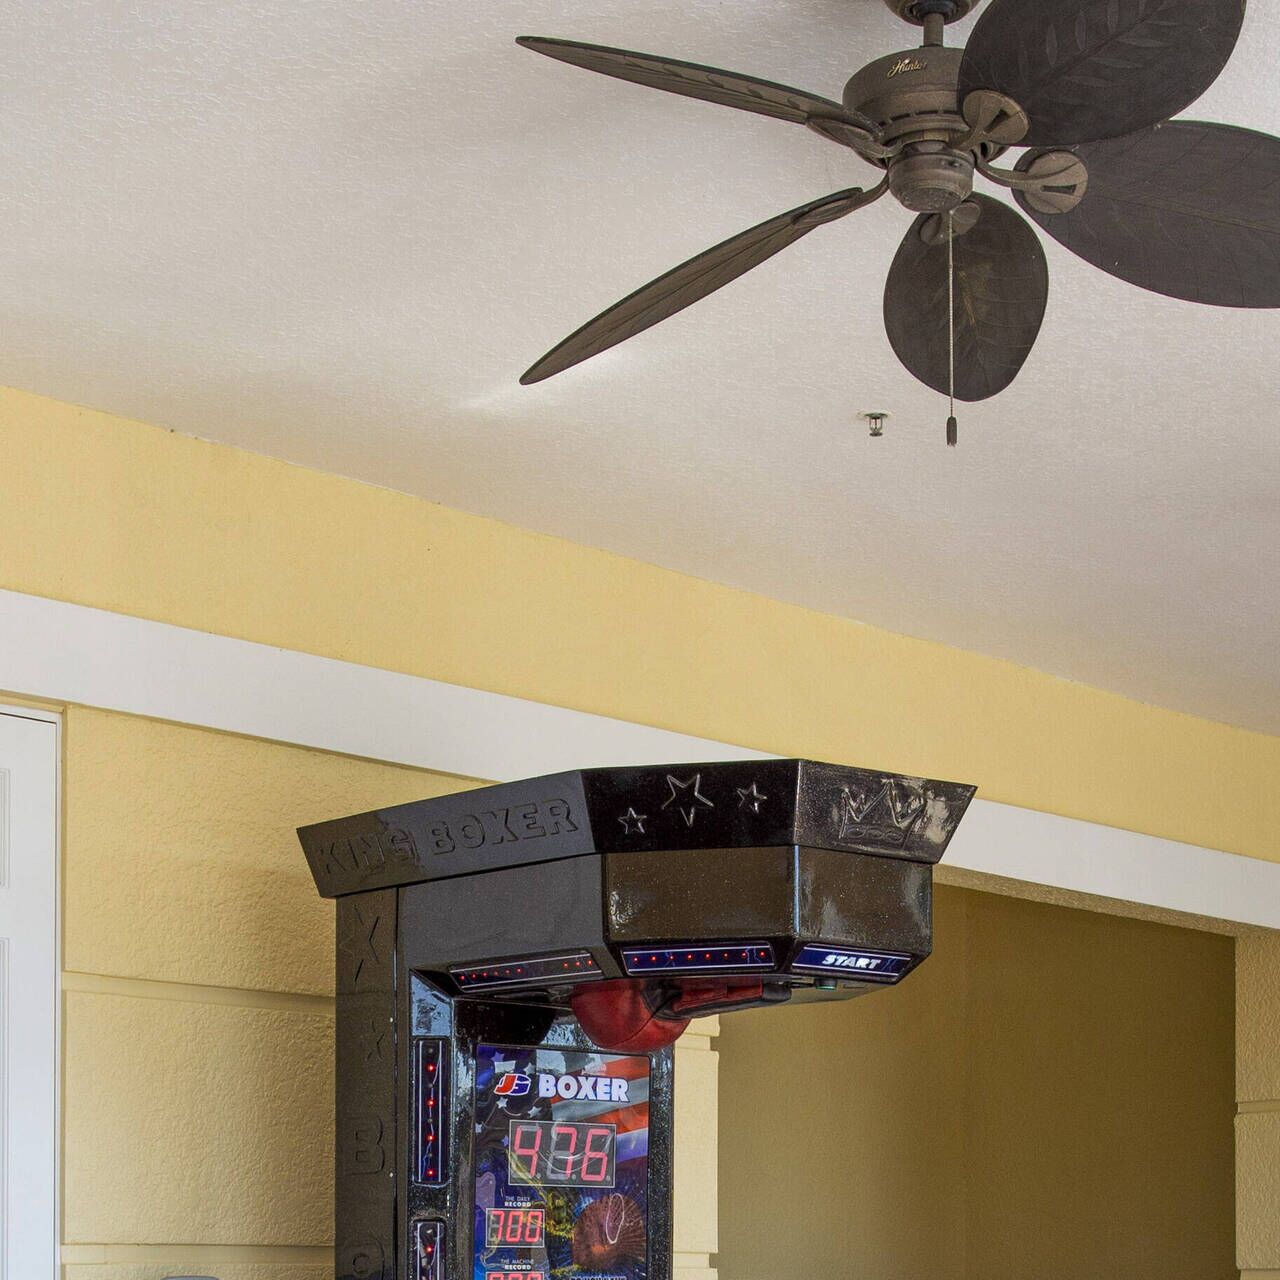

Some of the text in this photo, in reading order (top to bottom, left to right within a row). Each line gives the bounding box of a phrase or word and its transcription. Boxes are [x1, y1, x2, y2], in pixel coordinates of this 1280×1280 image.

[430, 798, 580, 856] BOXER
[822, 954, 881, 969] START
[538, 1073, 631, 1103] BOXER
[513, 1125, 612, 1182] 476
[490, 1210, 543, 1243] 700
